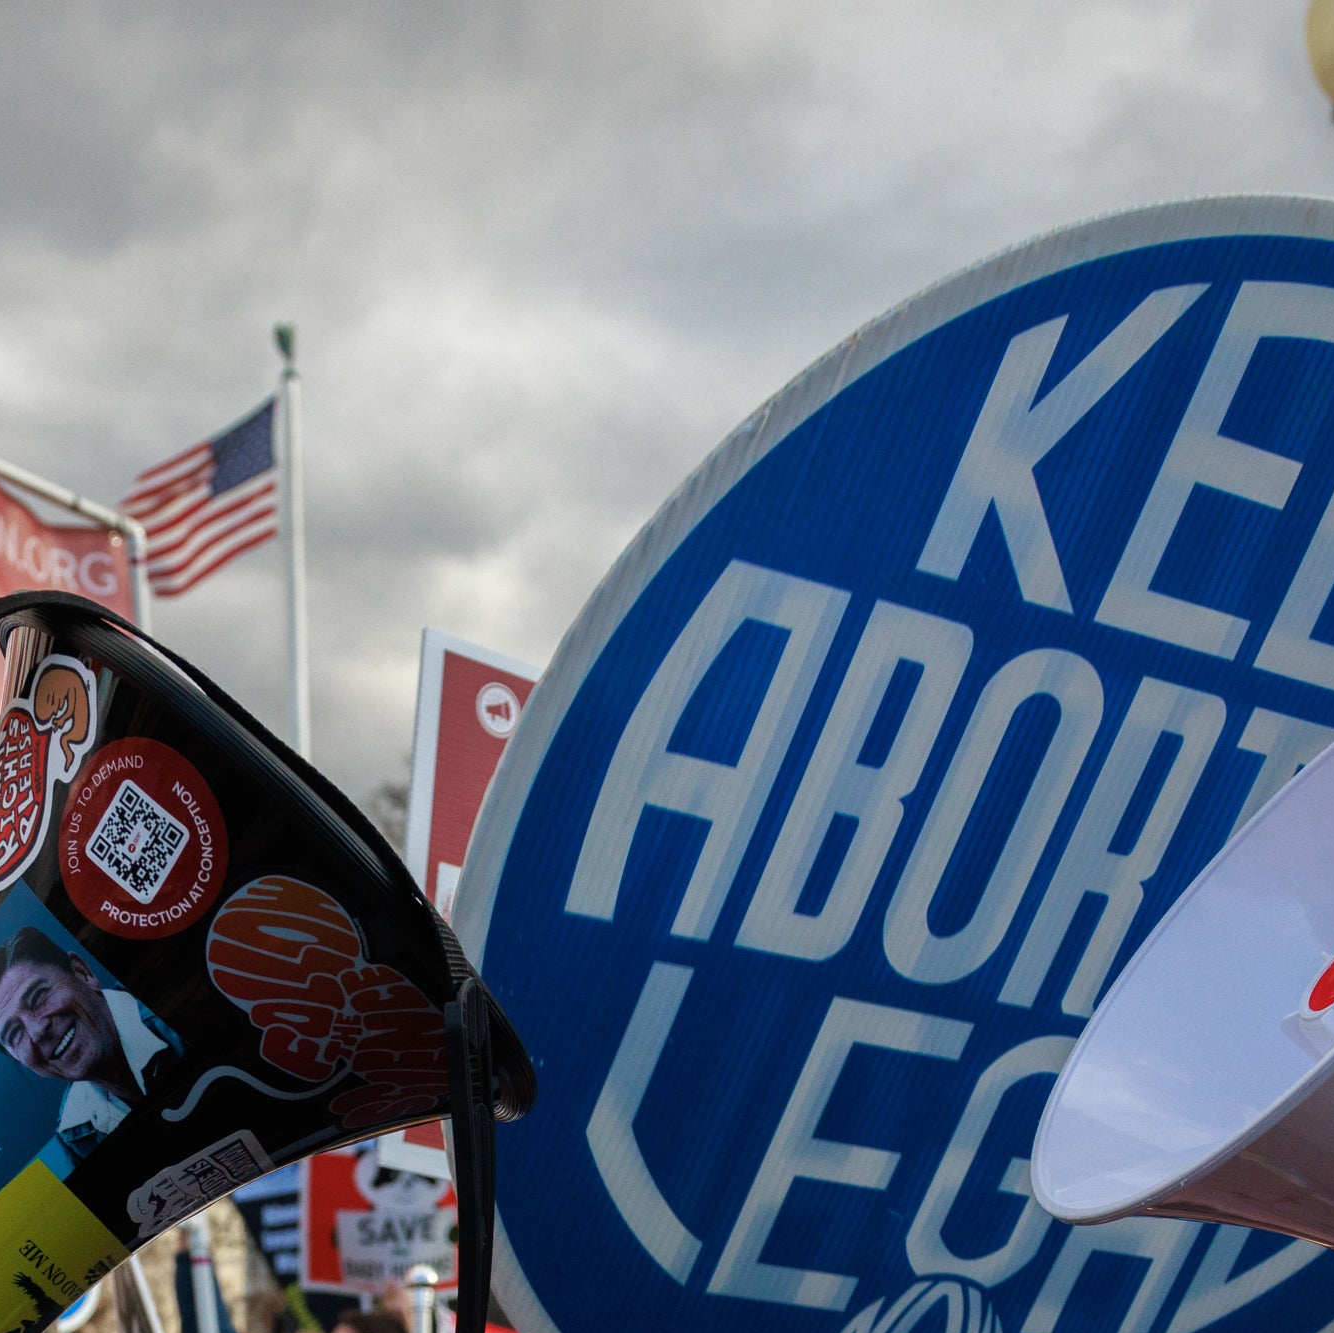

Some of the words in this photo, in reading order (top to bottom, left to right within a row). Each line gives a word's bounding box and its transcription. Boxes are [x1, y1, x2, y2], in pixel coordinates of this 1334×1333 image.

[17, 721, 39, 845] PLEASE
[91, 755, 144, 788] DEMAND
[78, 787, 93, 808] TO
[69, 812, 82, 834] US
[171, 781, 214, 883] CONCEPTION
[67, 840, 82, 875] JOIN
[188, 881, 205, 904] AT
[100, 899, 193, 928] PROTECTION
[208, 876, 359, 1081] FOLLOW
[324, 1012, 362, 1062] THE
[328, 965, 452, 1129] SCIENCE
[357, 1214, 433, 1246] SAVE
[19, 1239, 49, 1267] ME
[44, 1264, 67, 1285] ON
[60, 1275, 85, 1300] EAD
